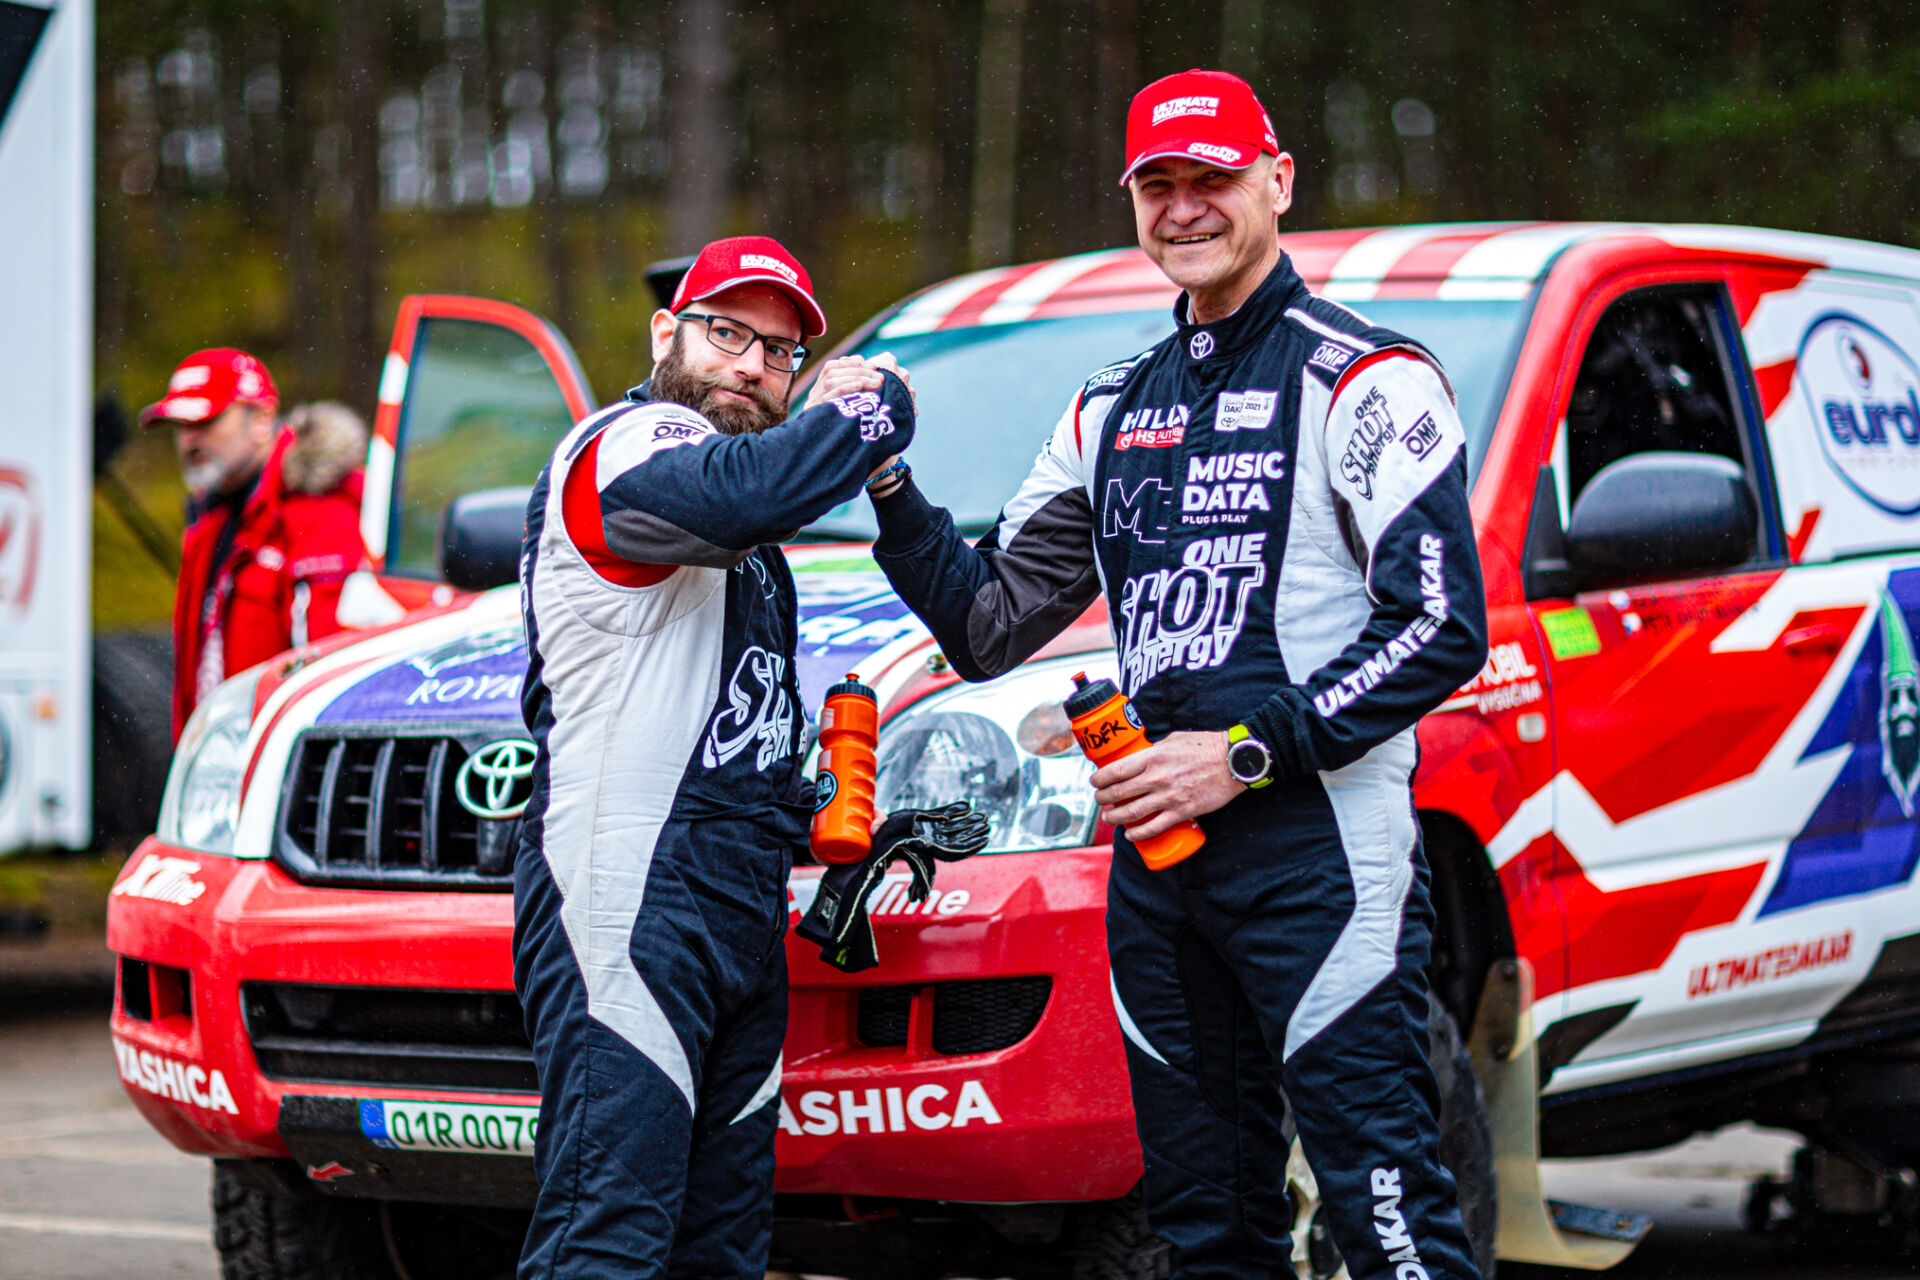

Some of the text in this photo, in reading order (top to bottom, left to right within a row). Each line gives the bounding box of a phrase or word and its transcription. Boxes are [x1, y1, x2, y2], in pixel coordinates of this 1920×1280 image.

[1313, 345, 1350, 369] OMP
[1244, 401, 1262, 411] 2021
[1354, 384, 1380, 420] ONE
[1135, 429, 1157, 444] HS
[1405, 415, 1439, 456] OMP
[1187, 451, 1285, 483] MUSIC
[1182, 483, 1271, 512] DATA
[1182, 514, 1210, 525] PLUG
[1221, 514, 1249, 524] PLAY
[1183, 533, 1267, 566] ONE
[1127, 632, 1236, 700] energy
[406, 673, 523, 706] ROYA
[113, 1034, 240, 1115] YASHICA
[777, 1079, 1003, 1136] ASHICA
[391, 1110, 462, 1149] 01R
